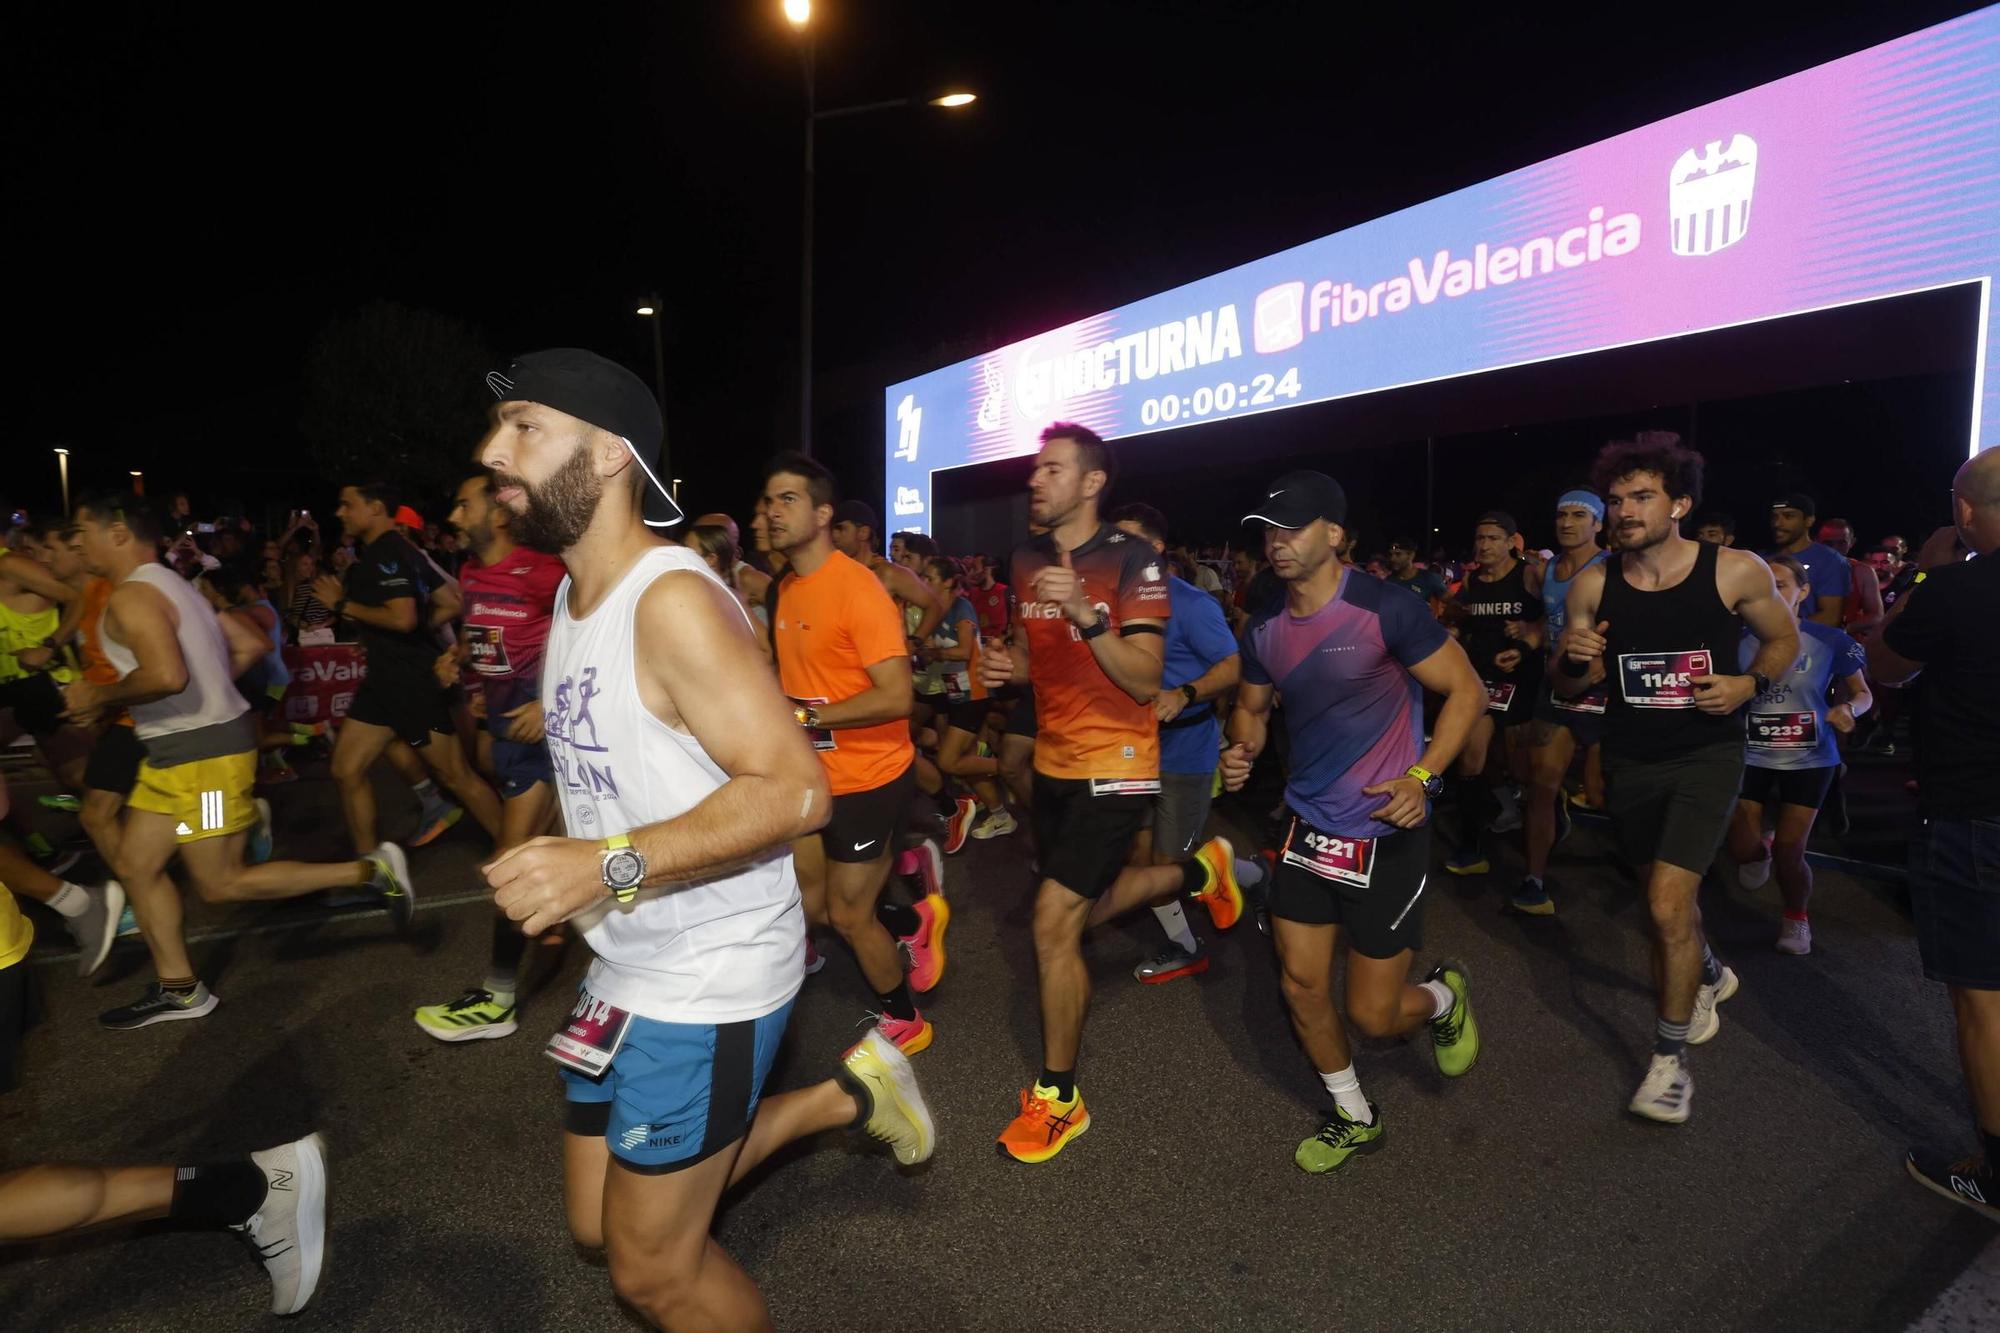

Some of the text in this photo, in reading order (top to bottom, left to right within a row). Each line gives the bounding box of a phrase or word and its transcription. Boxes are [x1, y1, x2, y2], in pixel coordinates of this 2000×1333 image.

[1058, 304, 1242, 400] NOCTURNA
[1309, 205, 1642, 333] fibraValencia
[1141, 368, 1302, 425] 00:00:24
[1472, 602, 1523, 616] UNNERS
[1640, 672, 1692, 688] 1145
[1758, 725, 1804, 737] 9233
[1304, 831, 1355, 859] 4221
[649, 1136, 681, 1147] NIKE
